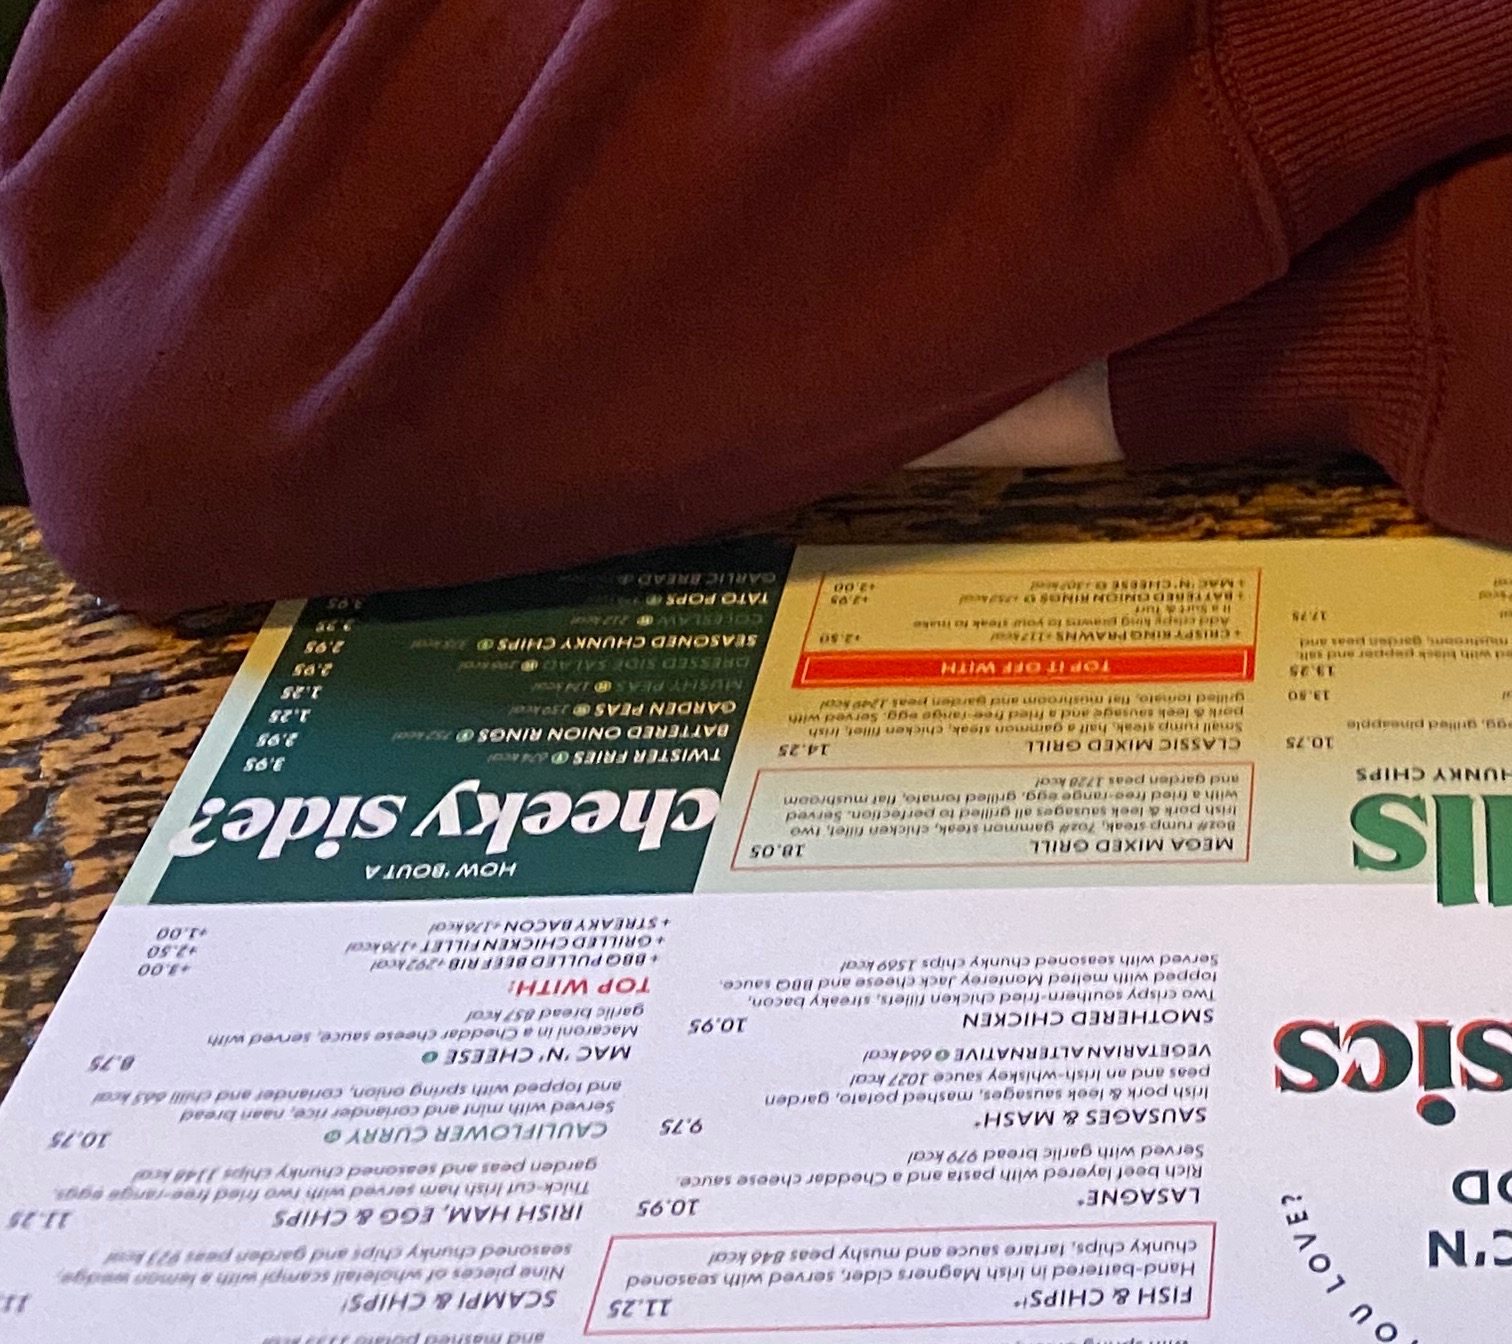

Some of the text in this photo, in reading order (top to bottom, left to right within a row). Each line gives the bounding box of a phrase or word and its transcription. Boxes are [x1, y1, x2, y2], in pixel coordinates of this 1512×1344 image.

[497, 634, 758, 650] SEASONED CHUNKY CHIPS
[594, 701, 736, 716] GARDEN PEAS
[478, 723, 729, 742] BATTERED ONION RINGS
[779, 743, 830, 756] 14.25
[1024, 738, 1241, 752] CLASSIC MIXED GRILL
[1286, 737, 1334, 749] 10.75
[574, 747, 721, 764] TWISTER FRIES
[1356, 767, 1425, 782] CHIPS
[167, 778, 721, 860] cheeky side?
[751, 844, 805, 858] 18.05
[1030, 837, 1234, 853] MEGA MIXED GRILL
[364, 862, 516, 879] HOW 'BOUT A
[508, 977, 650, 997] TOP WITH:
[688, 1017, 747, 1033] 10.95
[963, 1008, 1214, 1028] SMOTHERED CHICKEN
[444, 1048, 534, 1064] CHEESE
[575, 1045, 631, 1061] MAC
[87, 1055, 135, 1071] 8.75
[1064, 1110, 1078, 1125] &
[1086, 1107, 1206, 1124] SAUSAGES
[345, 1123, 608, 1144] CAULIFLOWER CURRY
[659, 1118, 703, 1135] 9.75
[48, 1131, 112, 1149] 10.75
[271, 1204, 584, 1227] IRISH HAM, EGG & CHIPS
[636, 1199, 700, 1217] 10.95
[7, 1211, 72, 1230] 11.25
[1281, 1195, 1345, 1294] LOVE?
[625, 1262, 1195, 1290] Hand-battered in Irish Magners cider, served with seasoned
[433, 1290, 557, 1310] SCAMPI &
[1113, 1287, 1192, 1305] FISH &
[608, 1299, 672, 1317] 11.25
